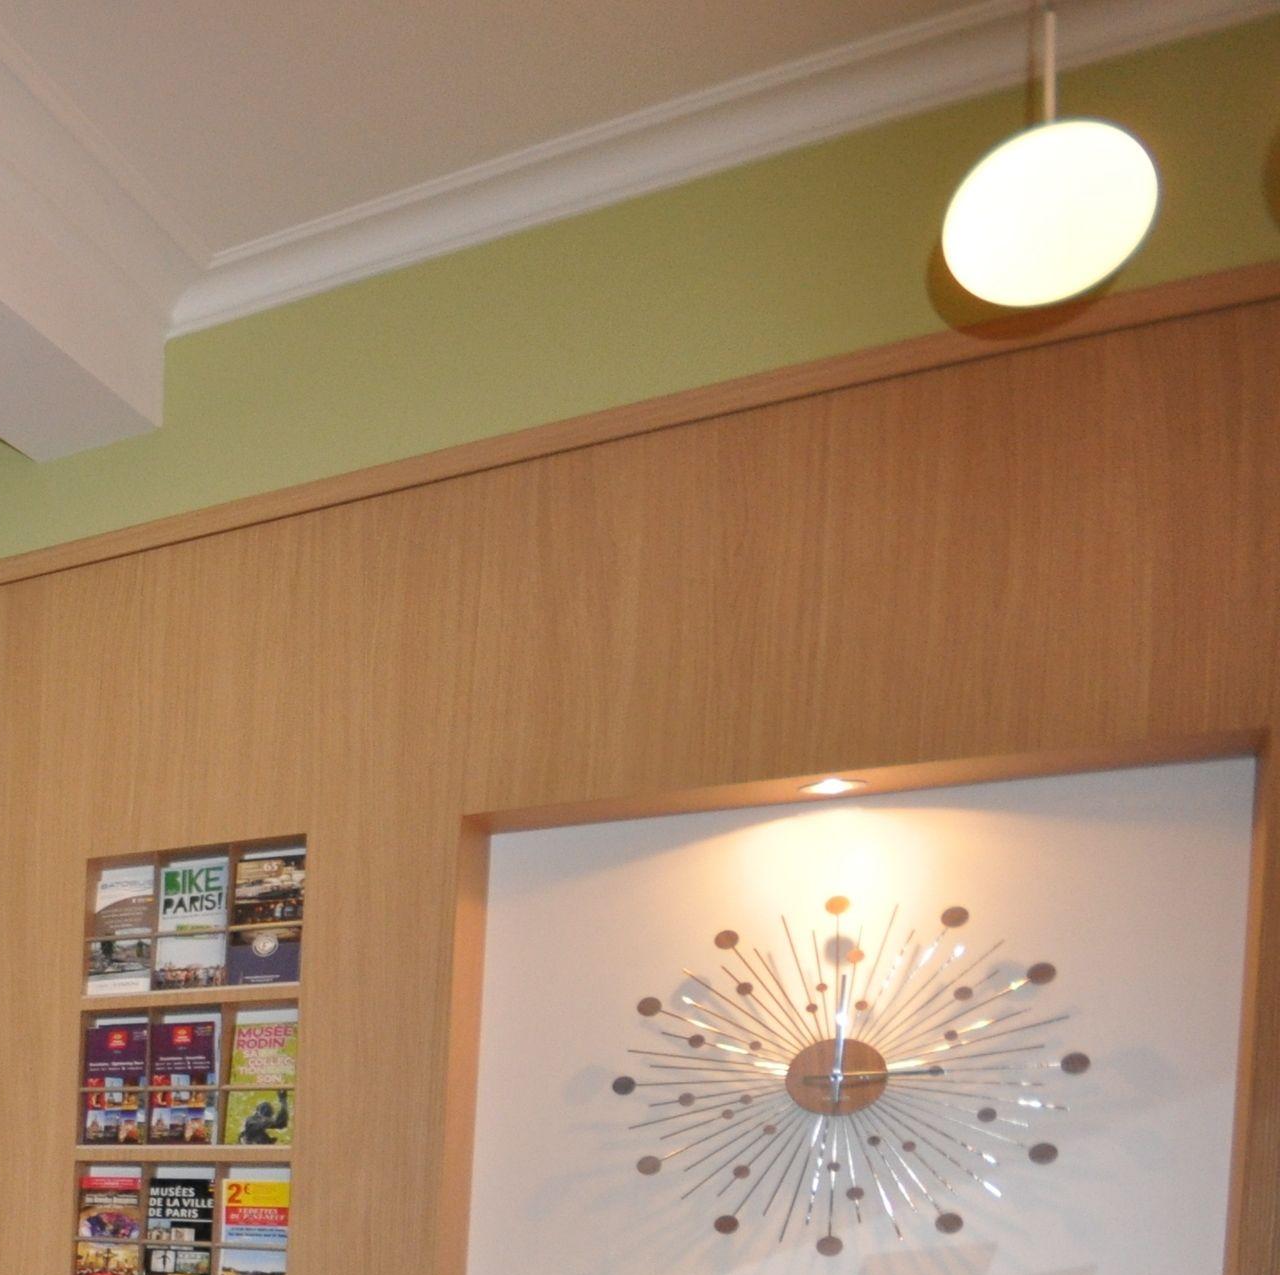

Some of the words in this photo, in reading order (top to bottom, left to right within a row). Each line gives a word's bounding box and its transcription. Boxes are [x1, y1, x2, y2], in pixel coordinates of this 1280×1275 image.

[164, 867, 224, 897] BIKE
[162, 893, 223, 915] PARIS!
[236, 1038, 285, 1050] RODIN
[150, 1185, 196, 1197] MUSÉES
[149, 1197, 163, 1207] DE
[166, 1198, 180, 1207] LA
[182, 1198, 215, 1208] VILLE
[148, 1207, 162, 1217] DE
[165, 1208, 199, 1219] PARIS
